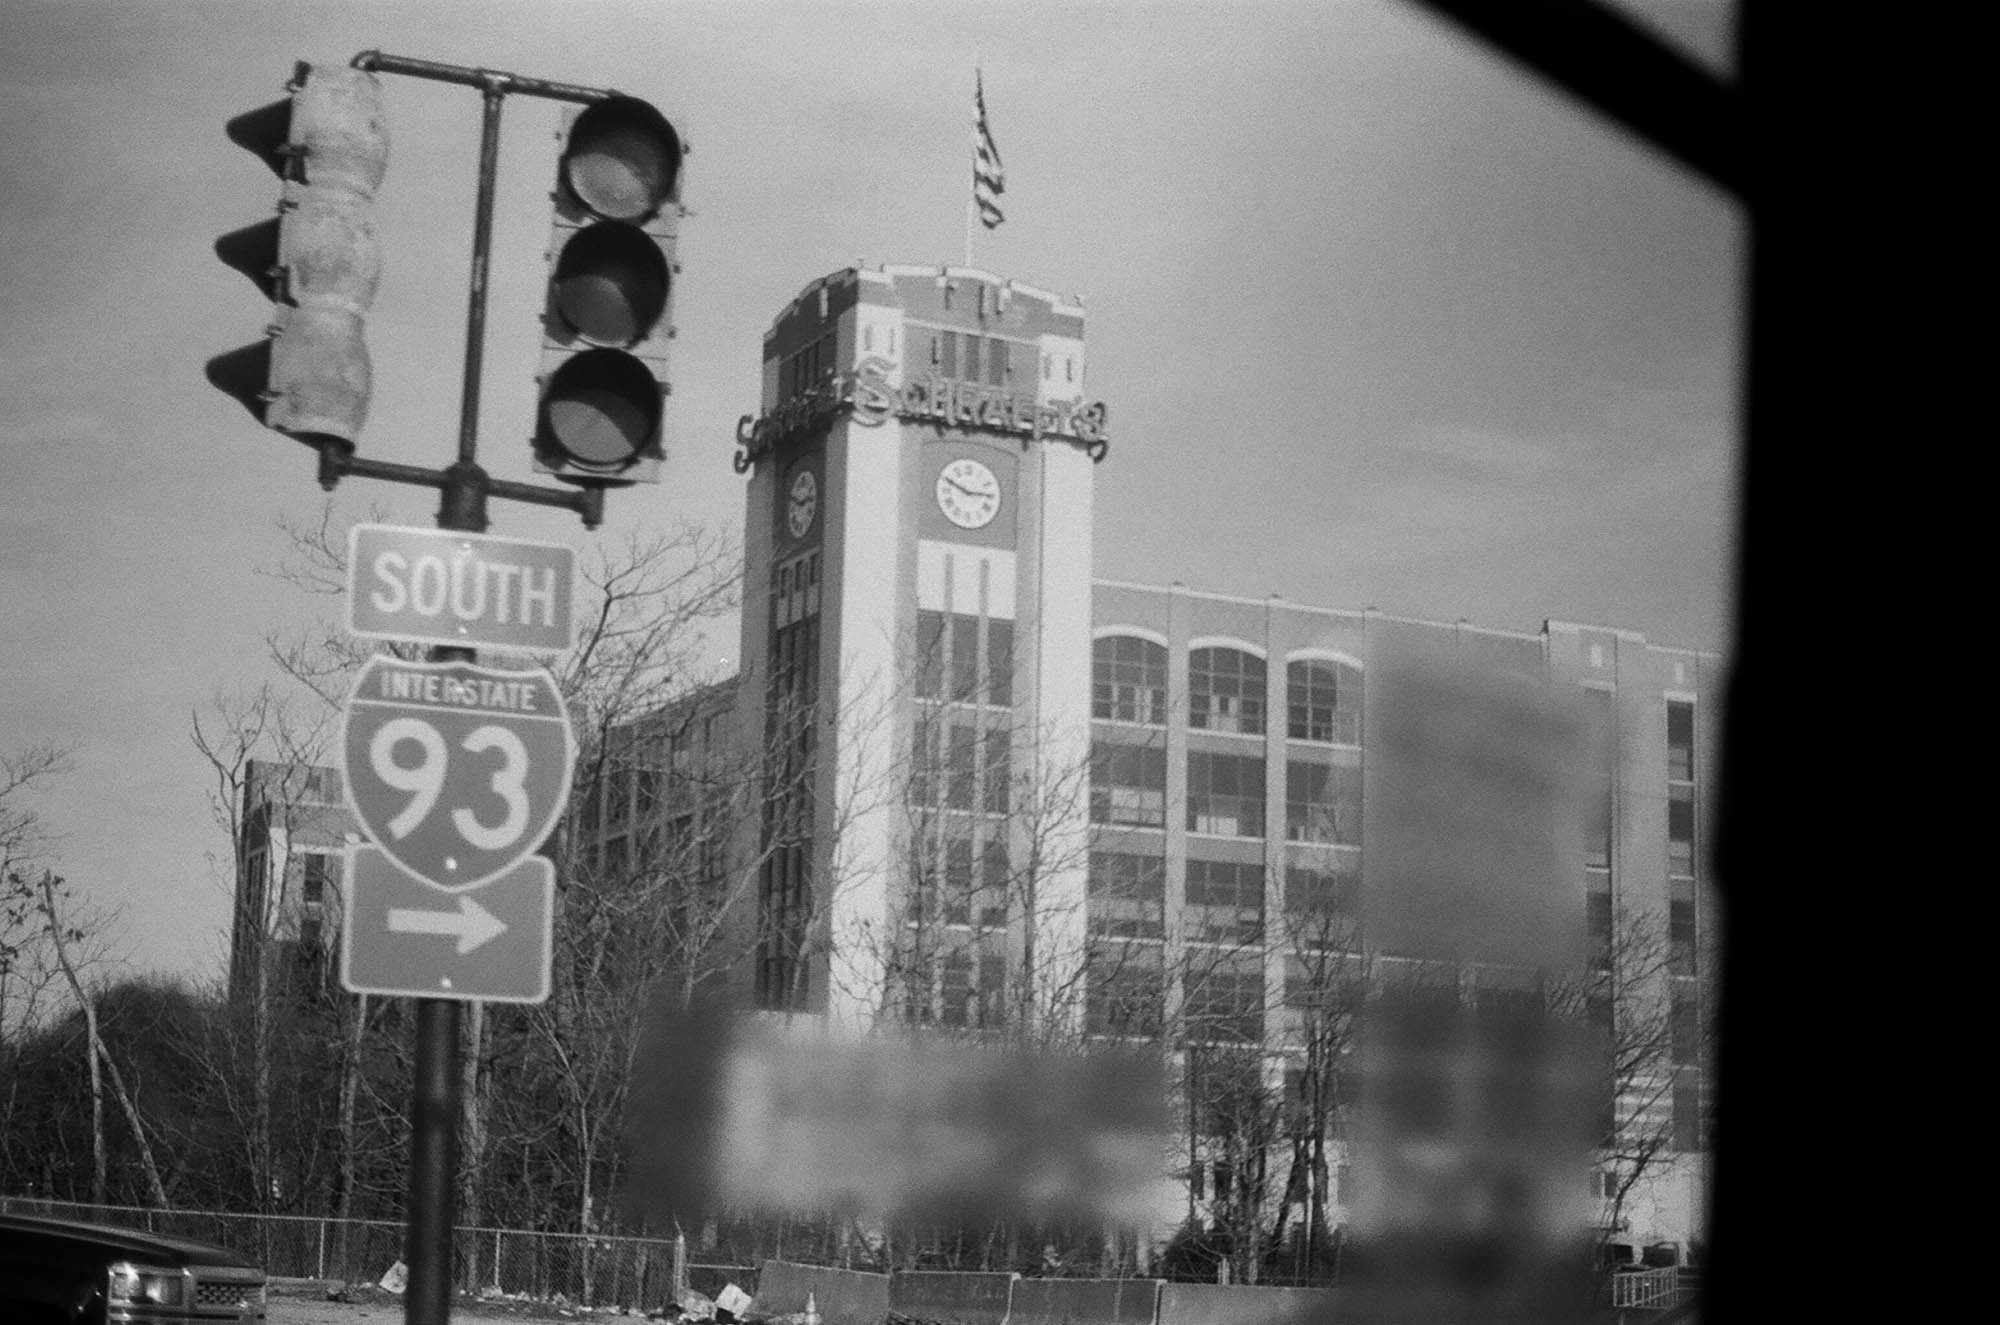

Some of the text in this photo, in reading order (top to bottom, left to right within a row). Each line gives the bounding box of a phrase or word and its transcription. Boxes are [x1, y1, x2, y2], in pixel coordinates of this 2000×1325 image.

[372, 552, 556, 627] SOUTH
[381, 671, 536, 710] INTERSTATE
[369, 717, 530, 850] 93
